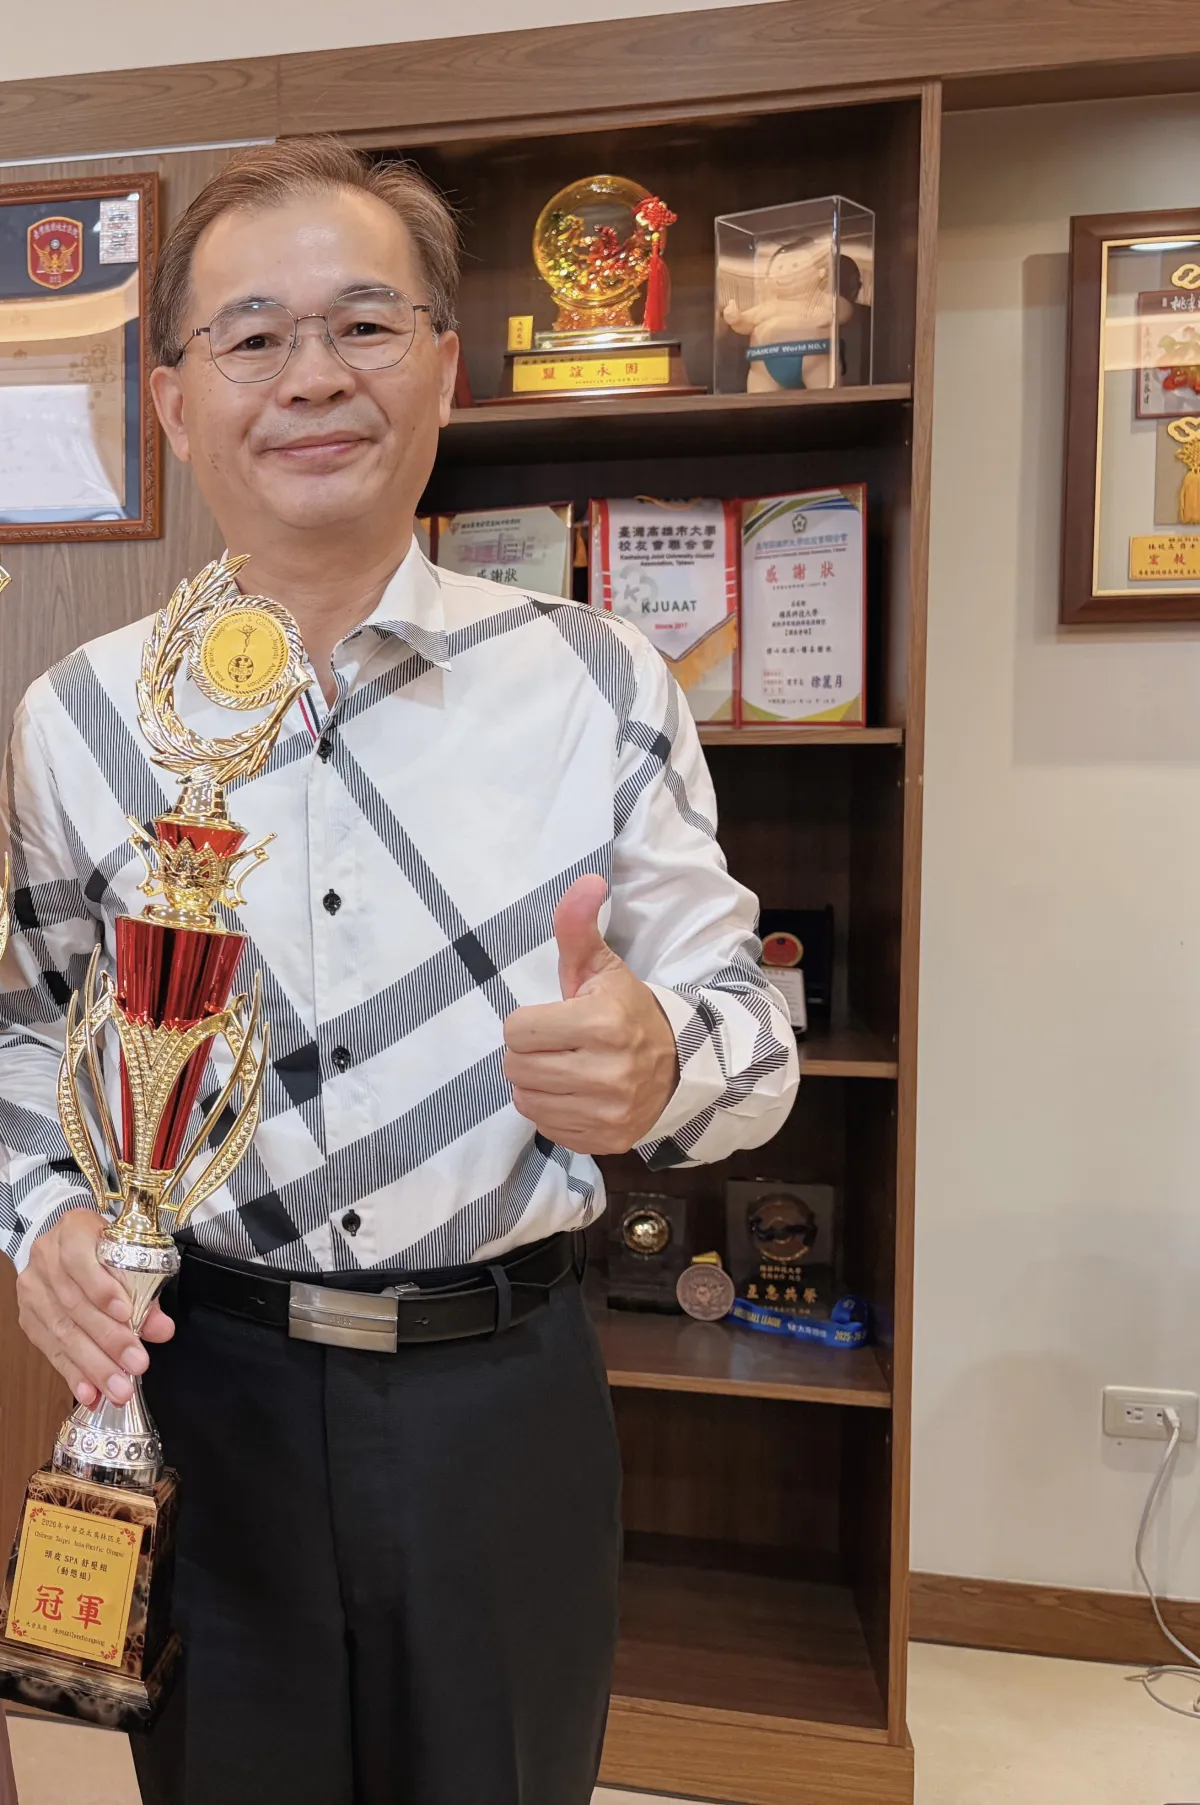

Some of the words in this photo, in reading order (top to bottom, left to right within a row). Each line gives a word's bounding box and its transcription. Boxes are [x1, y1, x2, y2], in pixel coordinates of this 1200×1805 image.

[618, 525, 716, 538] 臺灣高雄市大學
[618, 539, 714, 551] 校友會聯合會
[765, 561, 835, 583] 感謝狀
[641, 600, 697, 613] KJUAAT
[34, 1531, 53, 1541] Chinese
[56, 1536, 70, 1545] Taipei
[44, 1549, 61, 1562] 頭皮
[64, 1555, 78, 1565] SPA
[32, 1584, 104, 1630] 冠軍
